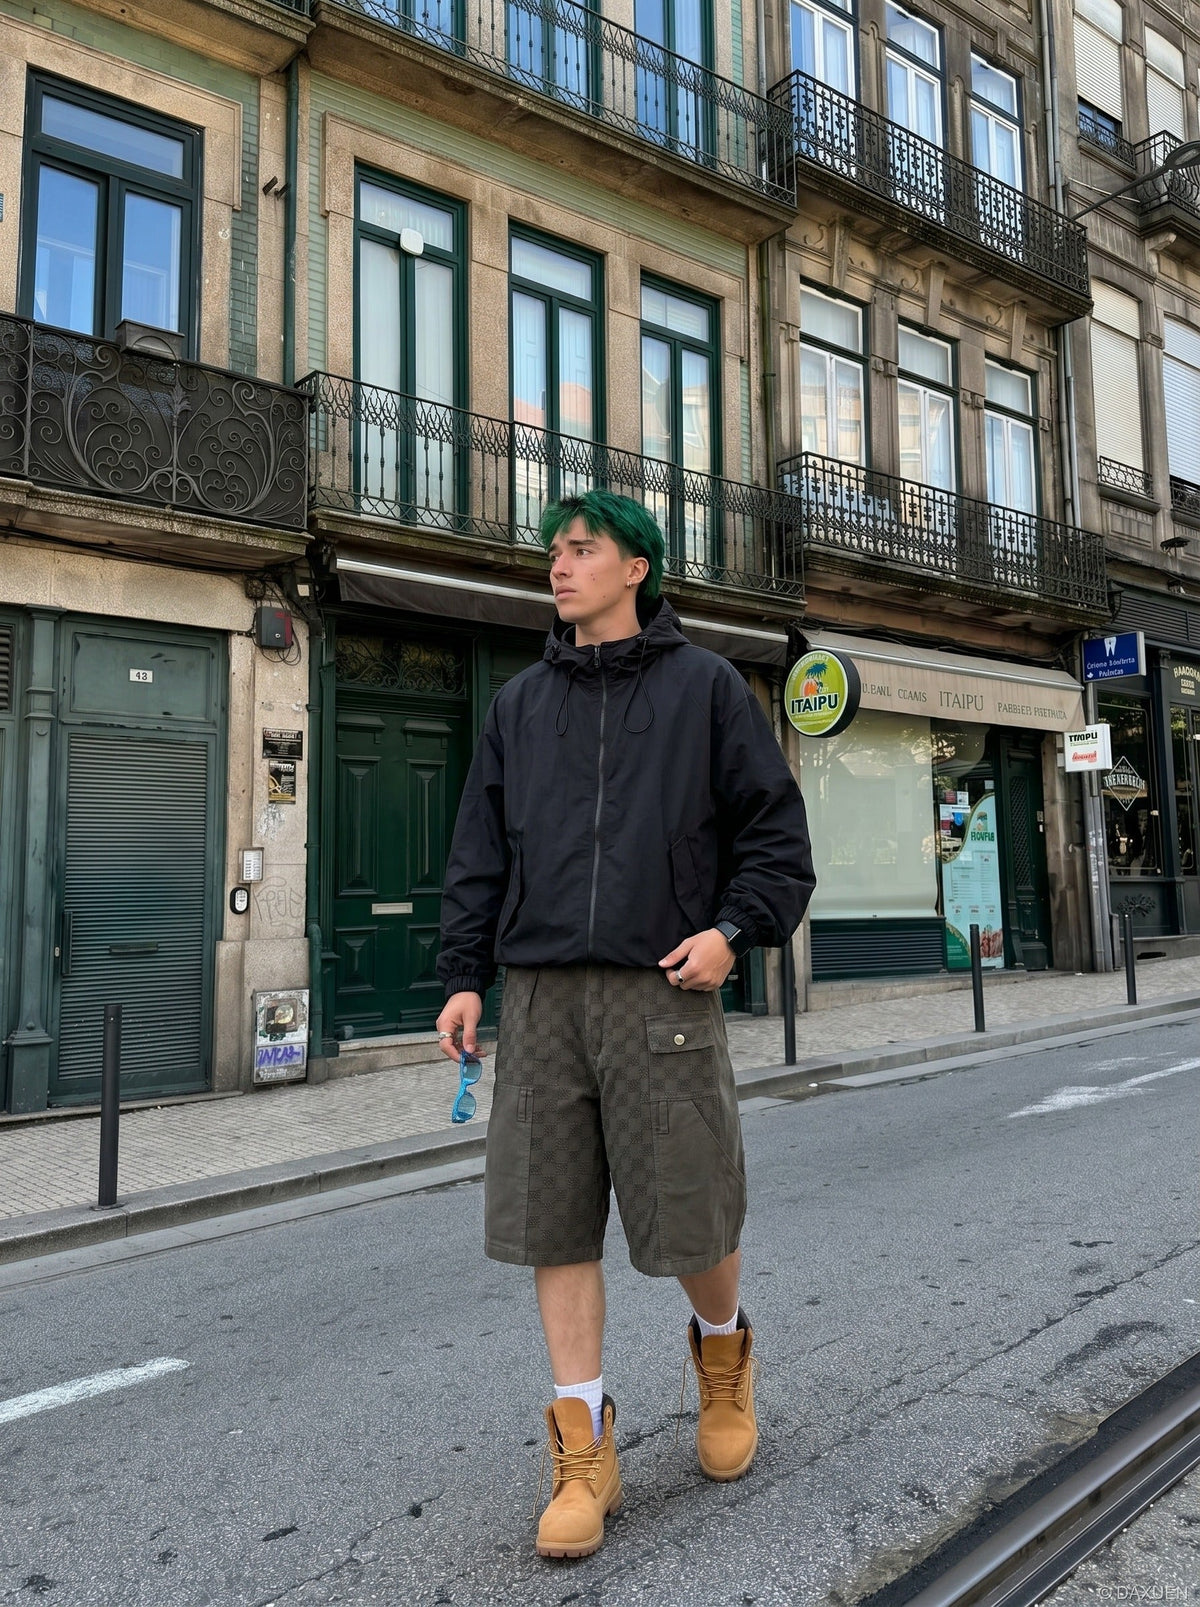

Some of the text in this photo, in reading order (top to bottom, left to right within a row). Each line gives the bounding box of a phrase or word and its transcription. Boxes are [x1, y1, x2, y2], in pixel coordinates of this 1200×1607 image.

[135, 671, 148, 681] 43
[791, 693, 839, 715] ITAIPU
[939, 690, 985, 712] ITAIPU
